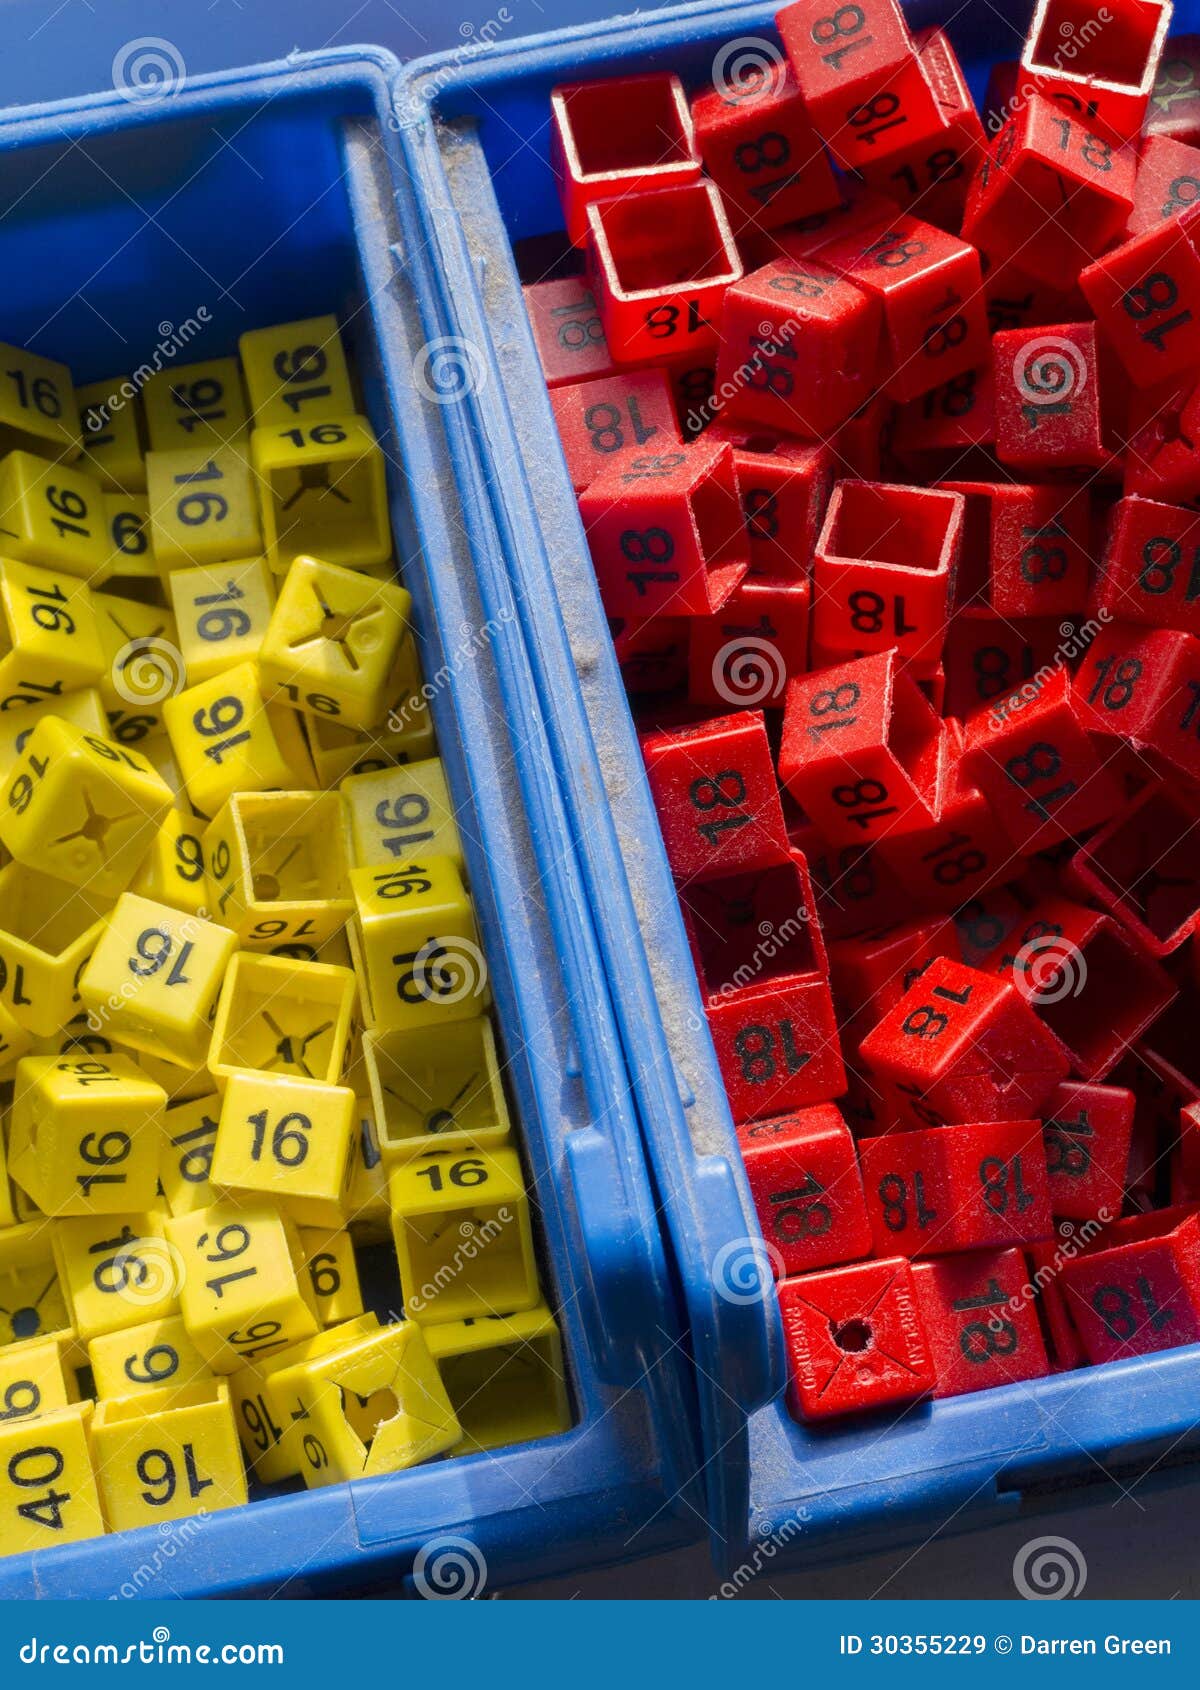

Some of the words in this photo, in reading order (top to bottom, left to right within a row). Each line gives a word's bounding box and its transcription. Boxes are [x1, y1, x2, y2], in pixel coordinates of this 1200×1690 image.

[810, 5, 873, 70] 18
[847, 93, 907, 144] 18
[1051, 117, 1112, 171] 18
[734, 132, 801, 207] 18
[893, 149, 964, 193] 18
[861, 232, 927, 267] 18
[769, 271, 836, 297] 18
[1123, 272, 1192, 350] 18
[552, 291, 606, 351] 18
[645, 300, 711, 338] 18
[924, 286, 968, 357] 18
[6, 370, 61, 418] 16
[173, 378, 226, 432] 16
[273, 345, 331, 413] 16
[279, 424, 347, 447] 16
[584, 395, 657, 453] 18
[174, 460, 228, 526] 16
[621, 454, 686, 484] 18
[46, 485, 90, 537] 16
[620, 527, 679, 595] 18
[1020, 524, 1068, 583] 18
[27, 584, 75, 635] 16
[193, 580, 251, 641] 16
[848, 590, 918, 637] 18
[278, 682, 341, 715] 16
[807, 682, 861, 743] 18
[1088, 656, 1143, 711] 18
[193, 696, 251, 764] 16
[9, 754, 49, 815] 16
[689, 769, 754, 845] 18
[832, 779, 898, 829] 18
[1006, 742, 1077, 821] 18
[375, 793, 434, 857] 16
[212, 840, 235, 915] 16
[374, 865, 432, 899] 16
[922, 833, 987, 886] 18
[128, 928, 195, 986] 16
[249, 919, 316, 939] 16
[392, 936, 452, 1004] 16
[902, 984, 973, 1039] 18
[58, 1062, 120, 1086] 16
[735, 1018, 811, 1083] 18
[76, 1131, 131, 1196] 16
[247, 1109, 312, 1167] 16
[1044, 1109, 1095, 1177] 18
[416, 1159, 489, 1191] 16
[879, 1170, 936, 1232] 18
[979, 1155, 1034, 1214] 18
[768, 1171, 832, 1244] 18
[88, 1225, 147, 1293] 16
[197, 1224, 257, 1298] 16
[954, 1278, 1017, 1364] 18
[1093, 1275, 1175, 1341] 18
[227, 1321, 288, 1358] 16
[241, 1395, 283, 1451] 16
[291, 1397, 329, 1469] 16
[8, 1446, 71, 1530] 40
[136, 1444, 214, 1506] 16
